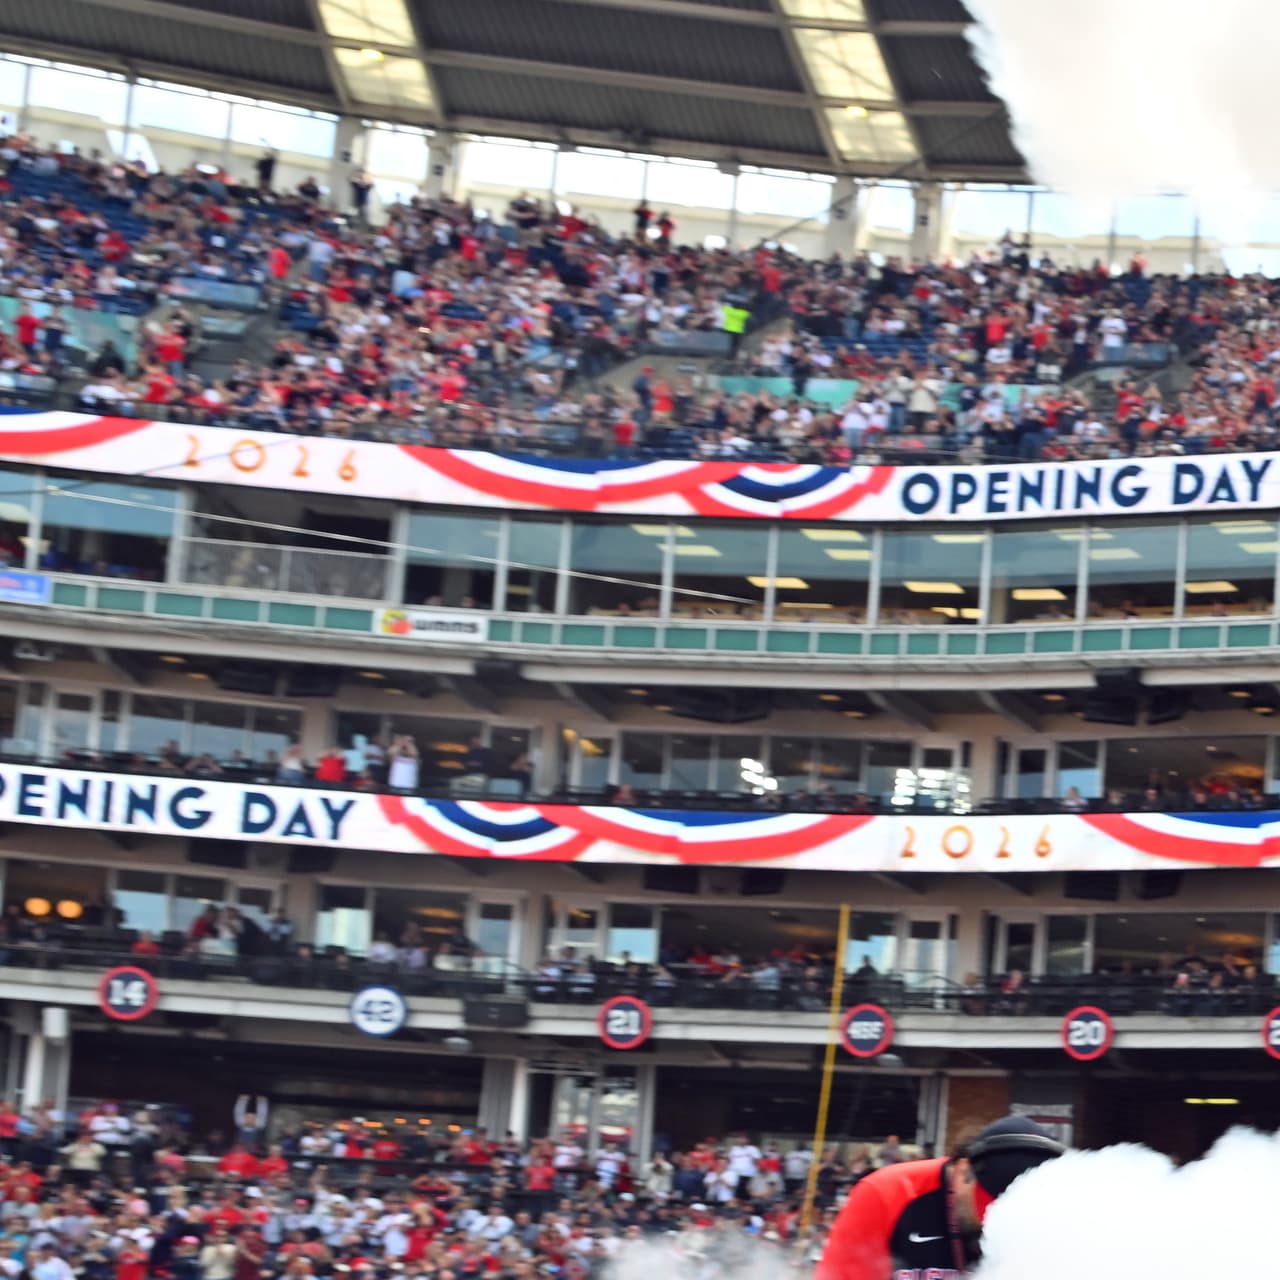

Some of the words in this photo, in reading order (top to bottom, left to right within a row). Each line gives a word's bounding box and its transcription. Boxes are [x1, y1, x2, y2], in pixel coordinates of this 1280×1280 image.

[185, 434, 358, 482] 2026
[902, 464, 1148, 515] OPENING
[1171, 458, 1272, 505] DAY
[0, 772, 214, 830] ENING
[241, 791, 356, 840] DAY
[900, 824, 1051, 859] 2026
[108, 979, 148, 1006] 14
[606, 1010, 640, 1035] 21
[1068, 1020, 1107, 1046] 20
